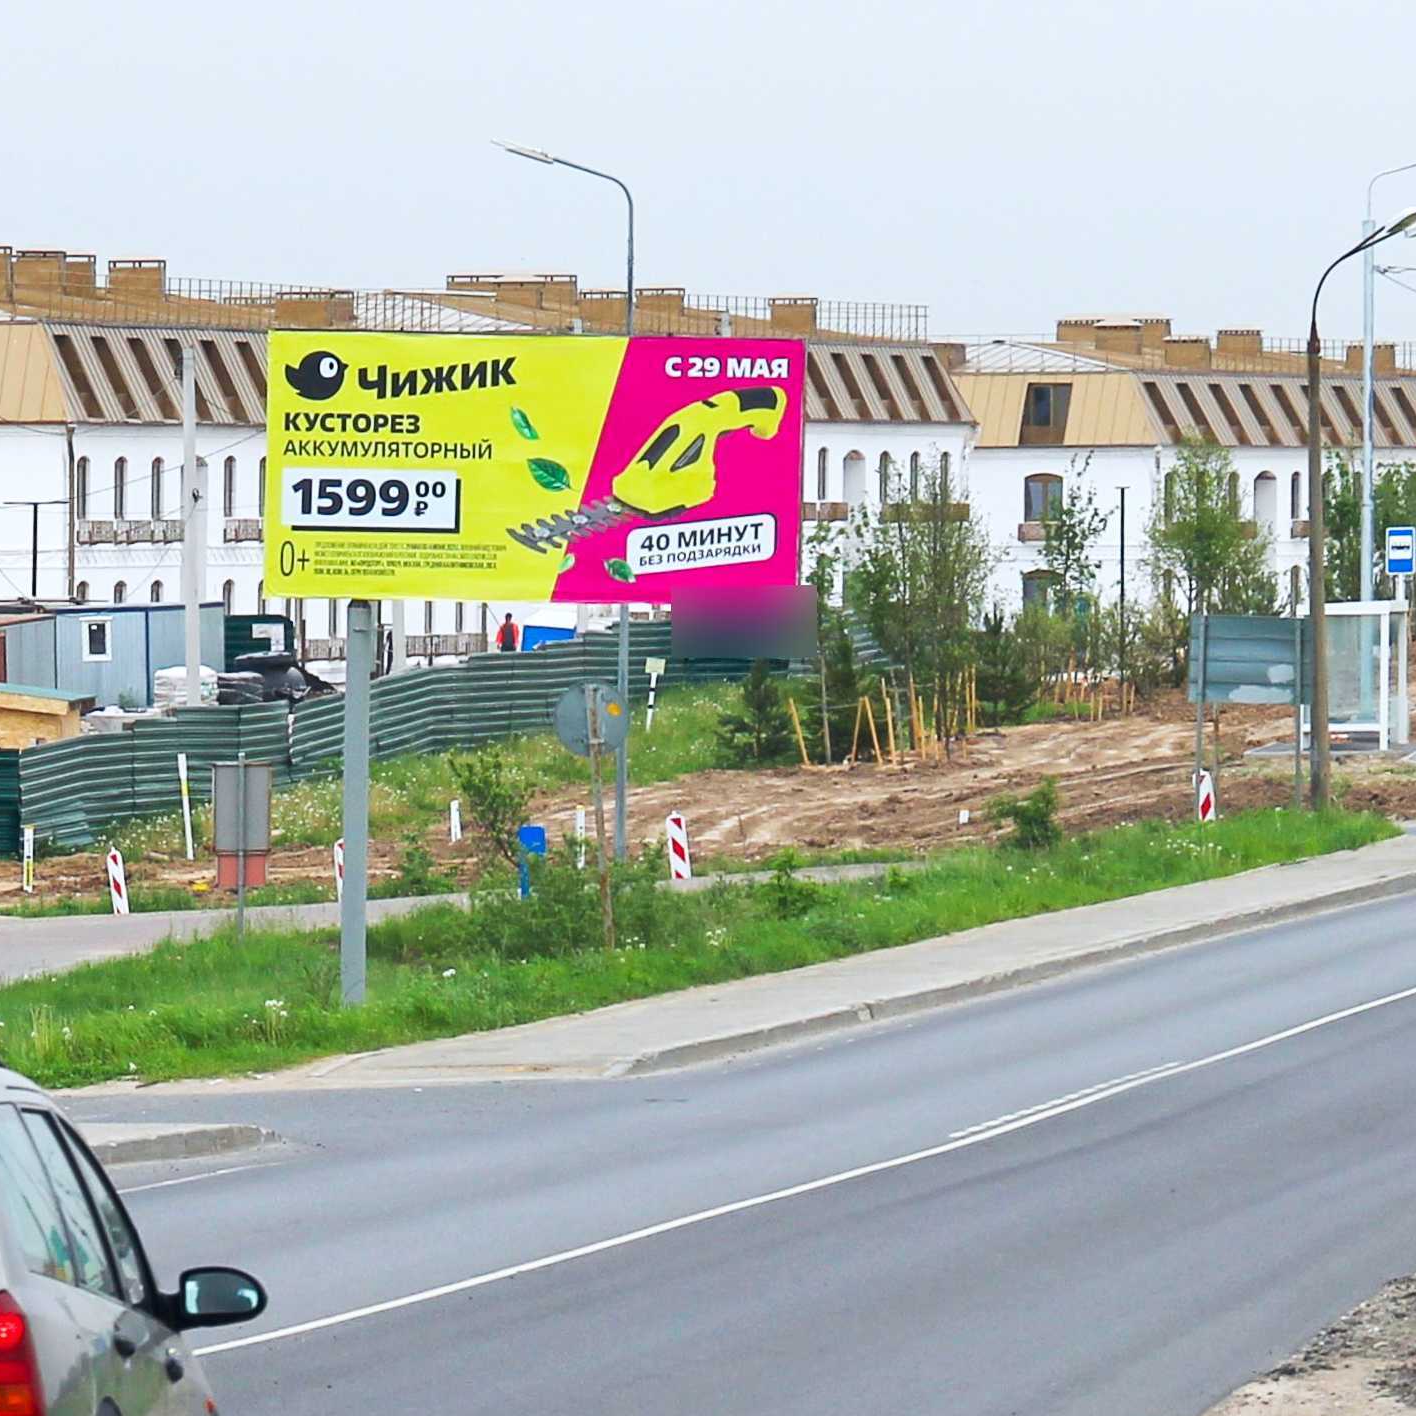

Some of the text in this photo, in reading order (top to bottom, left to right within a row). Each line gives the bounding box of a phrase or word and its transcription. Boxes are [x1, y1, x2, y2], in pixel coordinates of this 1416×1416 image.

[665, 357, 789, 379] С 29 МАЯ
[284, 412, 421, 434] КУСТОРЕЗ
[283, 438, 493, 460] АККУМУЛЯТОРНЫЙ
[291, 478, 446, 517] 1599 00
[641, 522, 764, 552] 40 МИНУТ
[280, 540, 310, 577] 0+
[639, 543, 761, 567] БЕЗ ПОДЗАРЯДКИ
